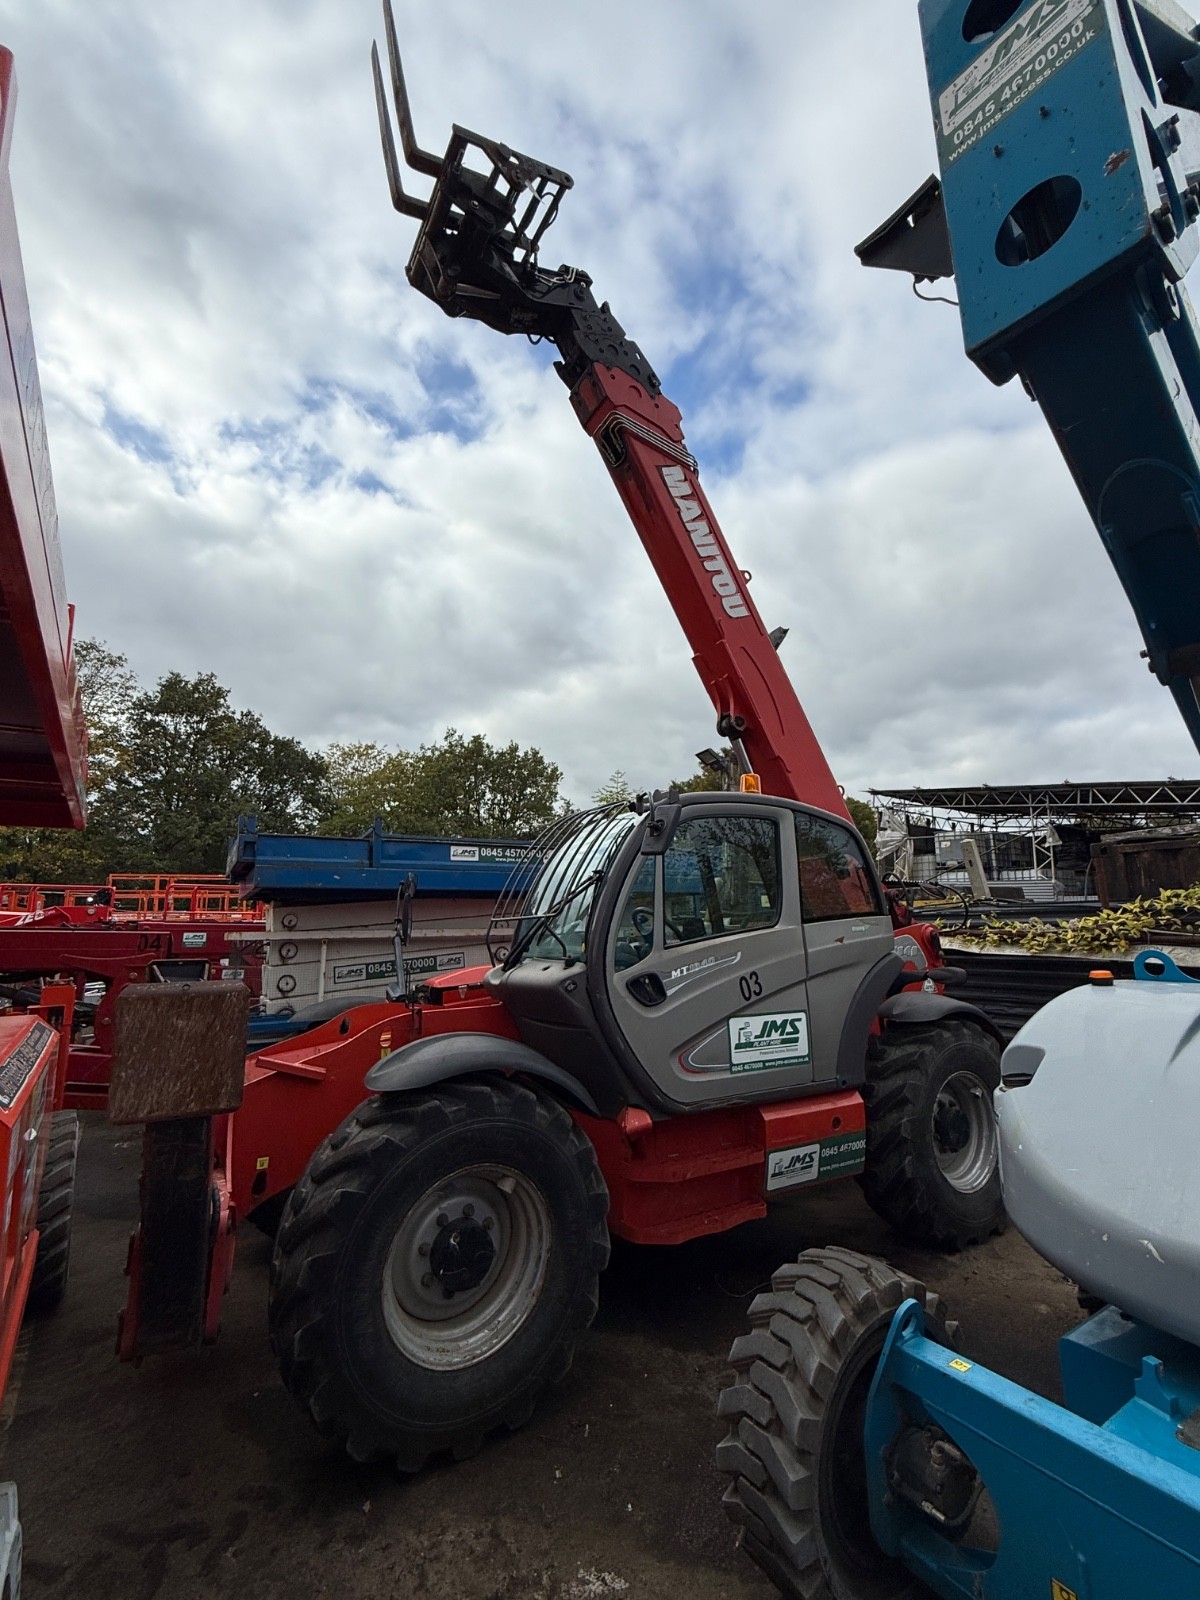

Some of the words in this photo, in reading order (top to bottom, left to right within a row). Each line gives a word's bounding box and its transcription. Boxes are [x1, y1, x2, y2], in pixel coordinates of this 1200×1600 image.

[953, 100, 995, 145] 0845
[1000, 20, 1084, 103] 4670000
[948, 29, 1096, 162] www.jms-access.co.uk
[661, 465, 750, 618] MANITOU
[481, 847, 503, 857] 0845
[368, 963, 393, 974] 0845
[739, 970, 763, 1002] 03
[754, 1018, 802, 1039] JMS
[784, 1151, 817, 1169] JMS
[821, 1145, 838, 1158] 0845
